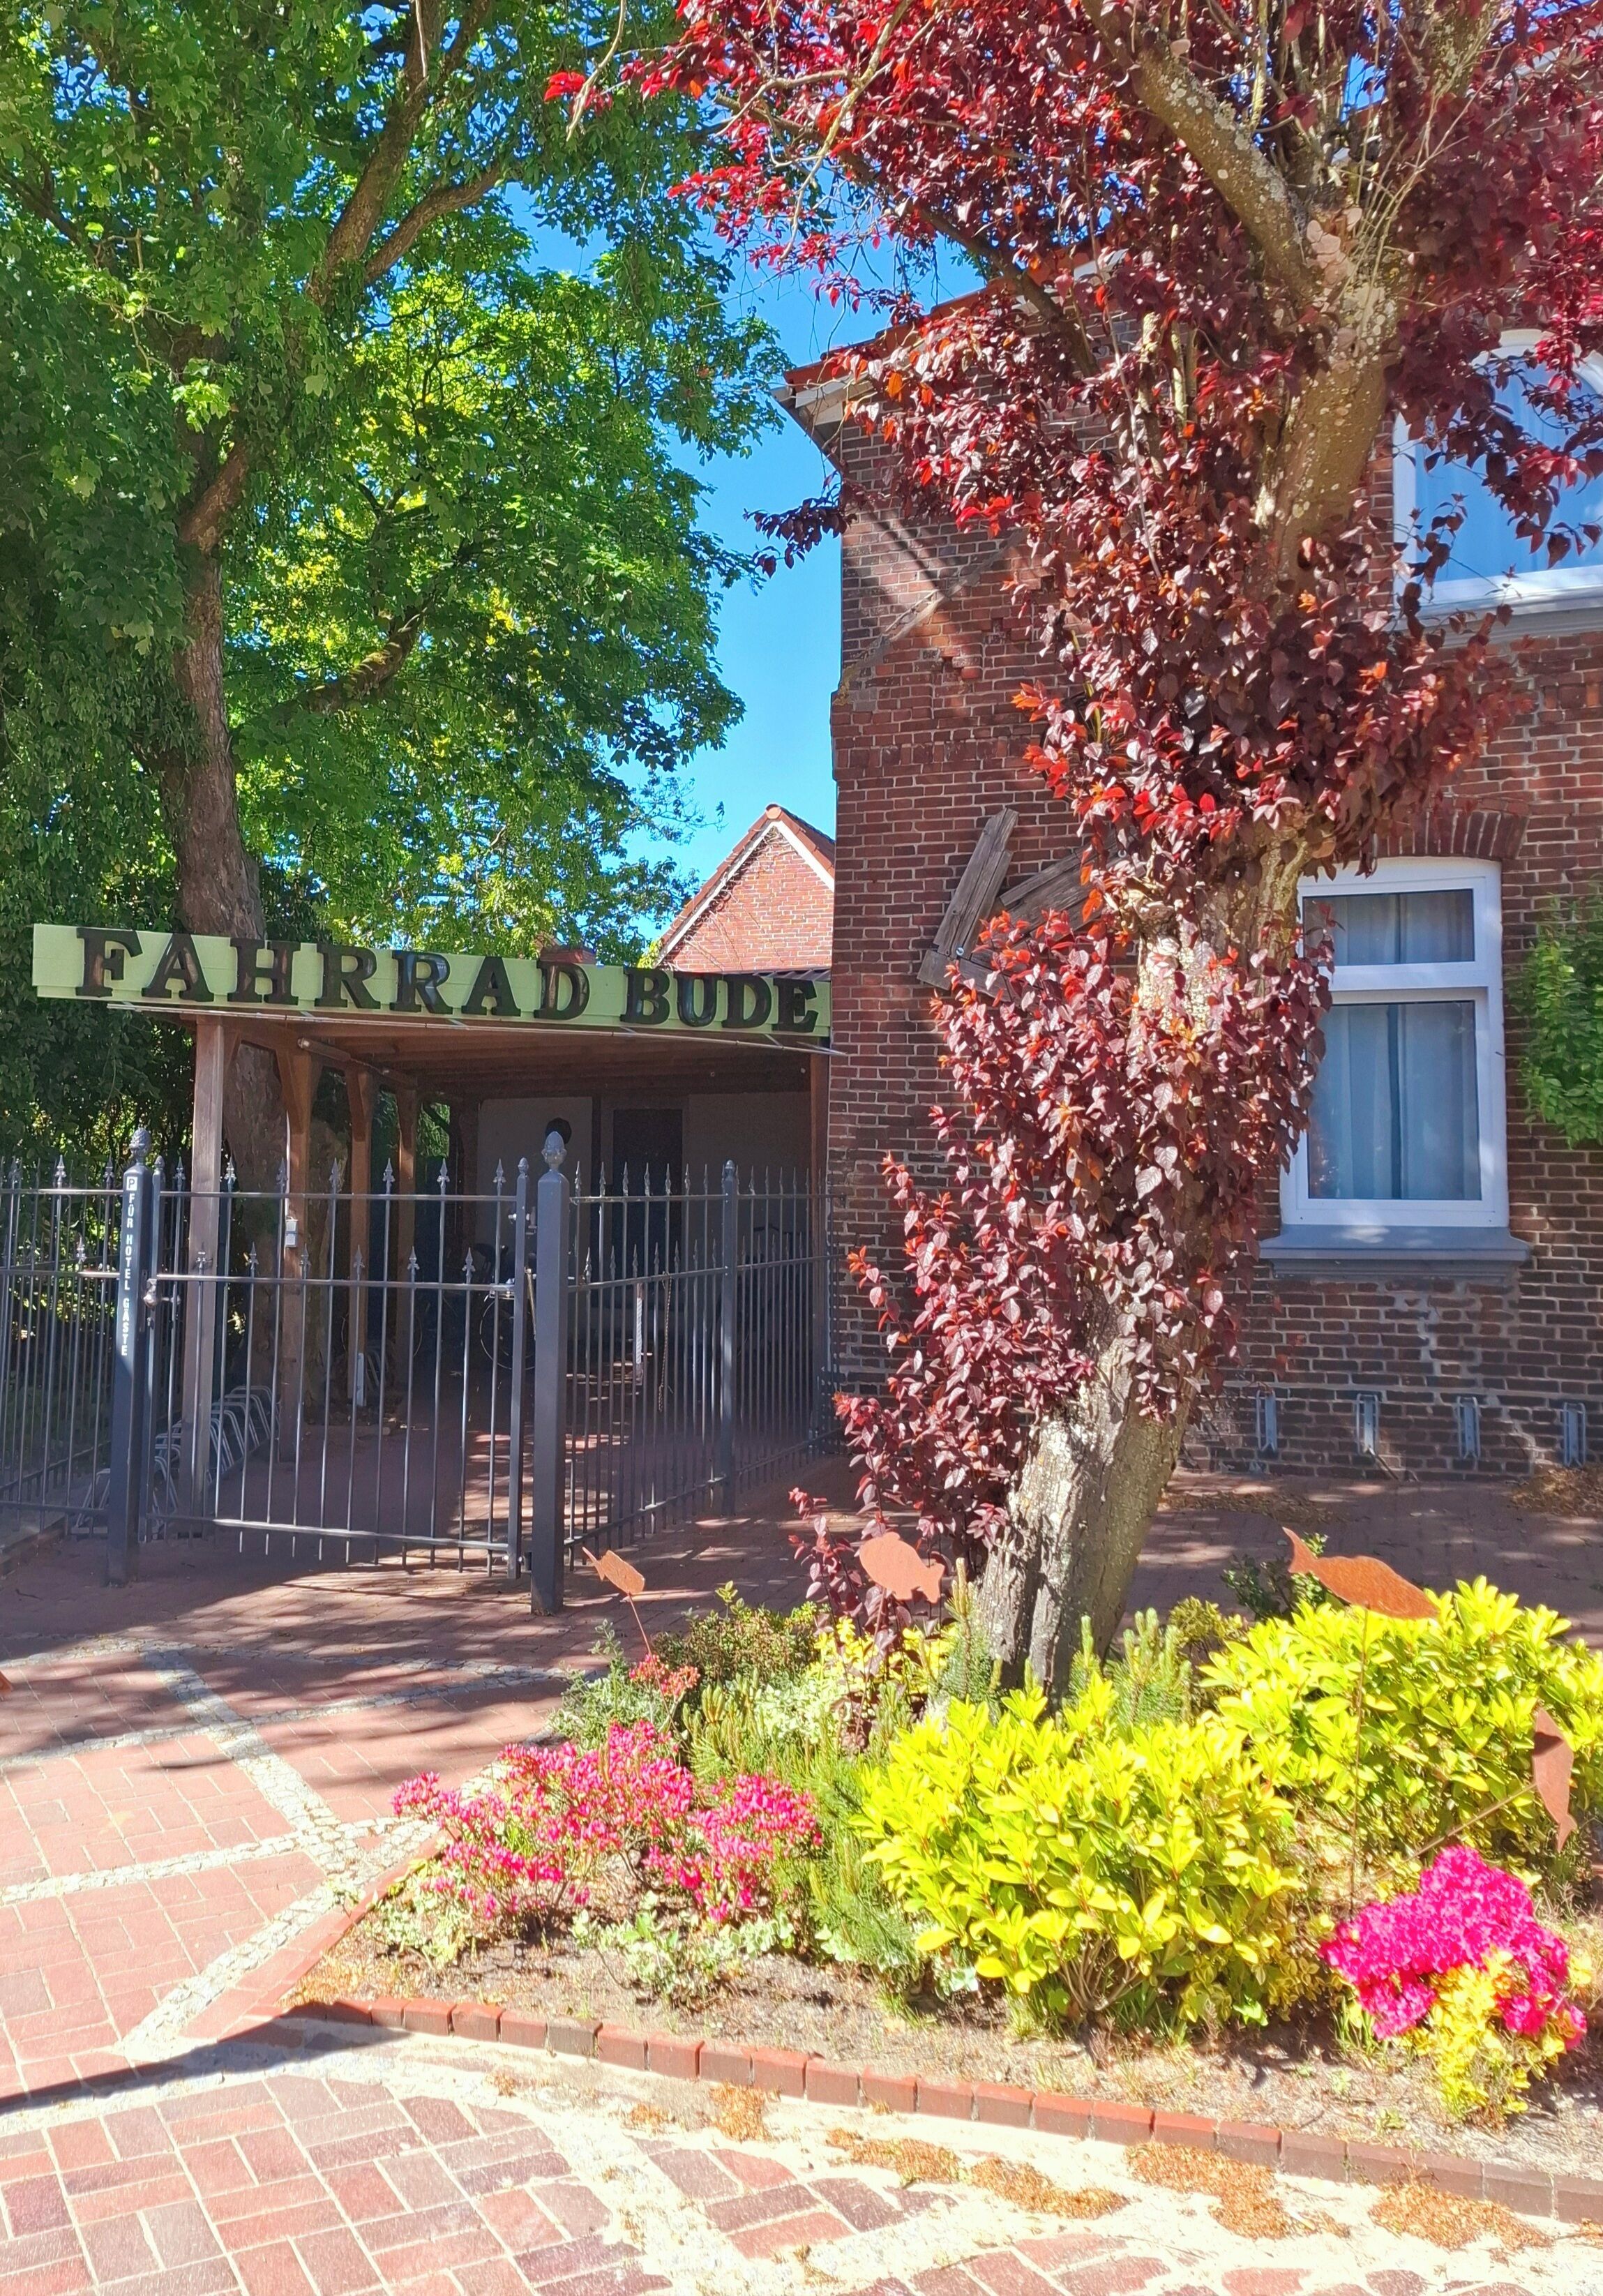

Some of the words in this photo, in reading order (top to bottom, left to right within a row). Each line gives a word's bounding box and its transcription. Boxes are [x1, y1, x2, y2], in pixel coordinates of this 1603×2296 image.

[75, 926, 591, 1021] FAHRRAD
[619, 966, 820, 1033] BUDE
[126, 1192, 135, 1229] FÜR
[124, 1233, 133, 1291] HOTEL
[121, 1297, 130, 1357] GÄSTE
